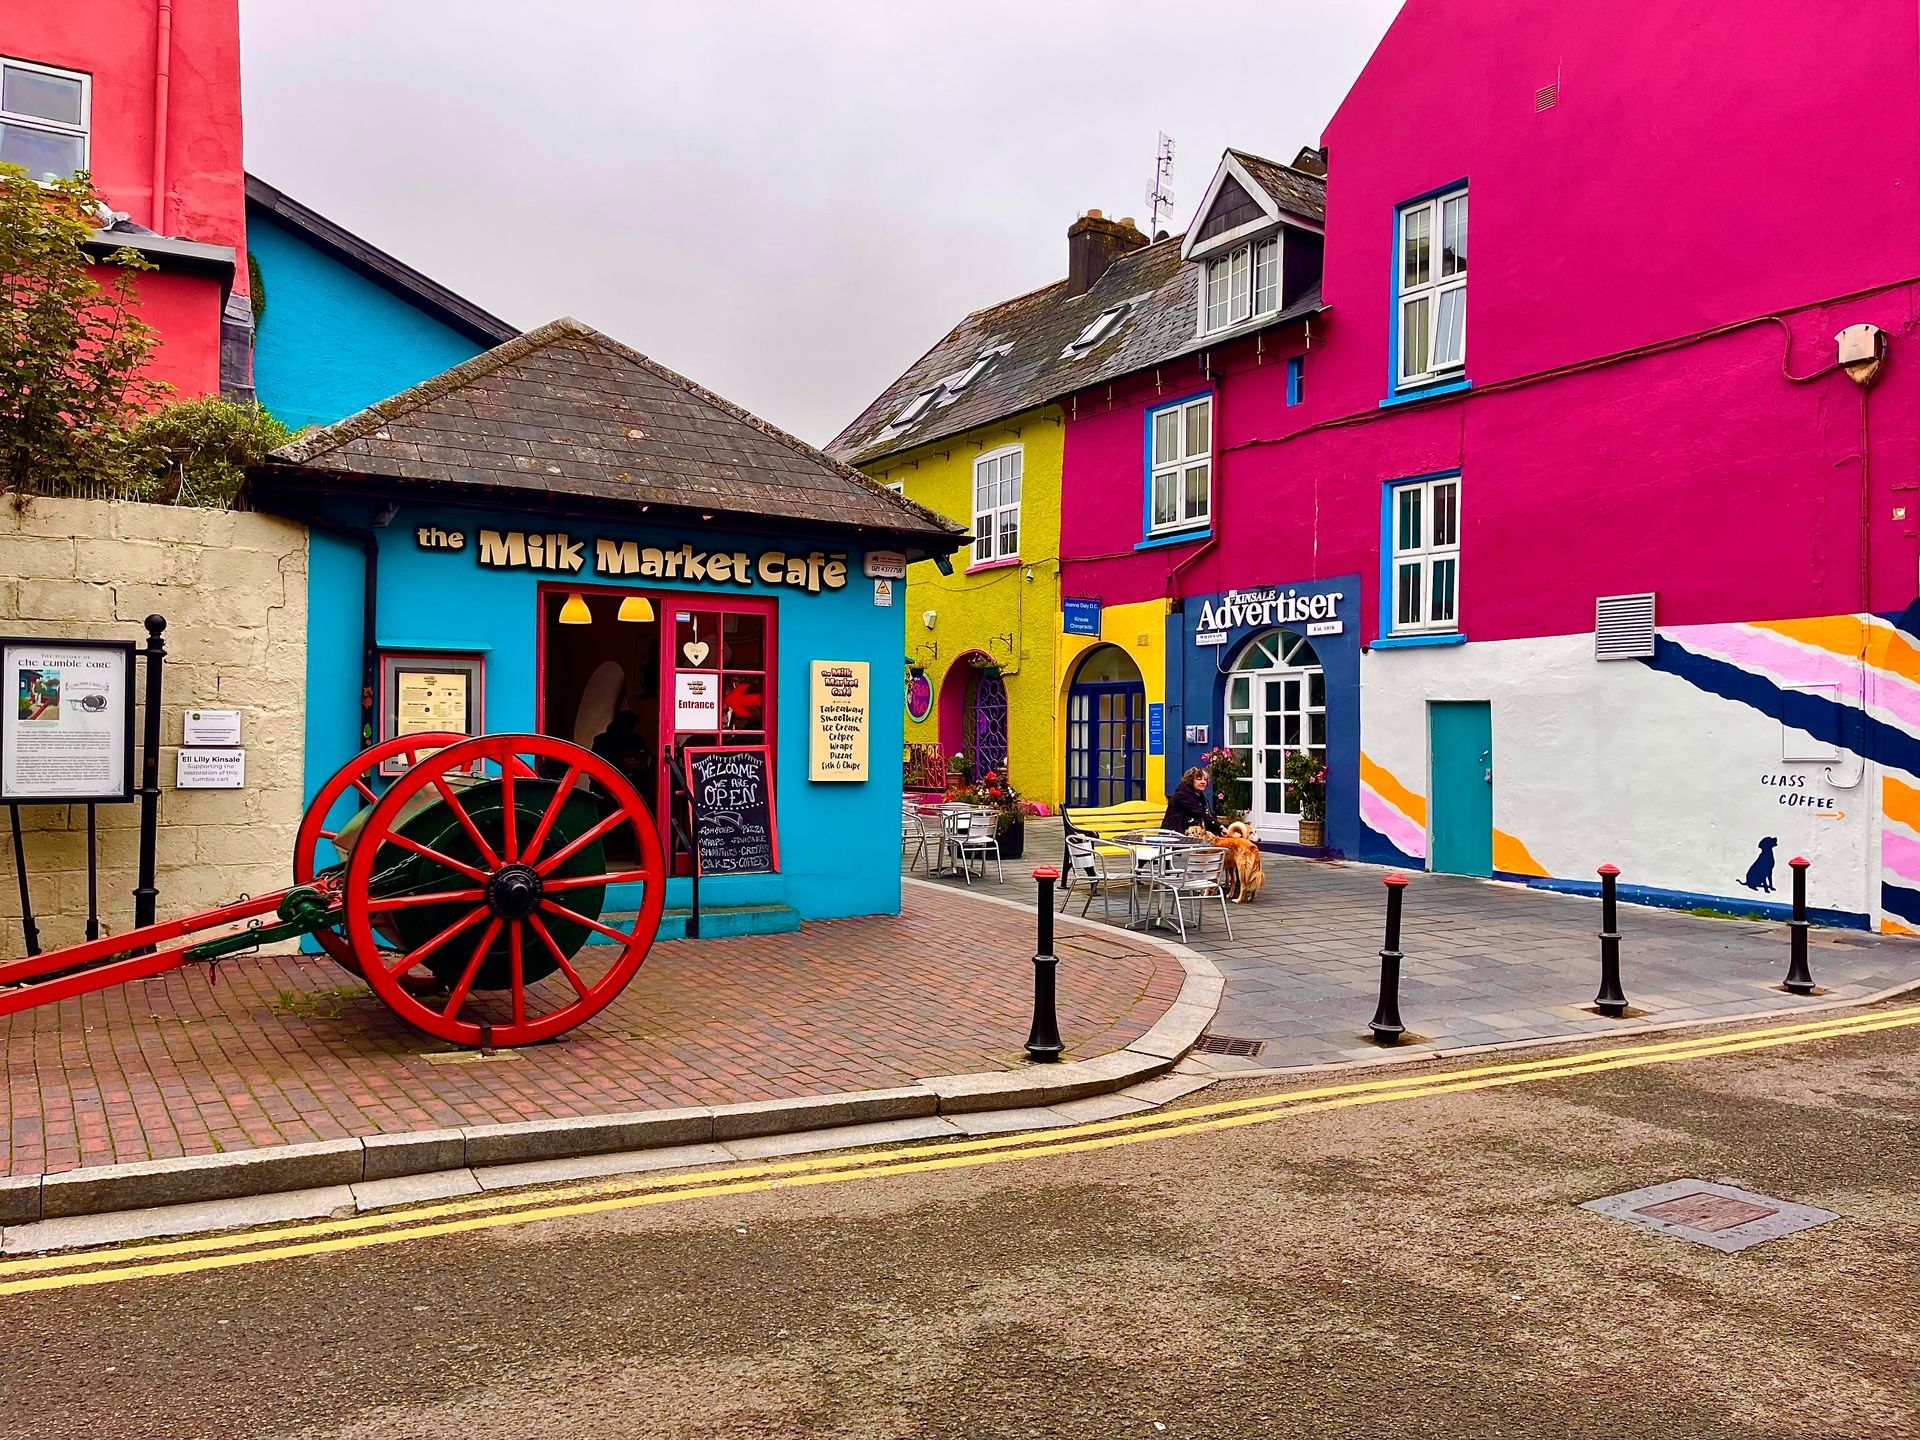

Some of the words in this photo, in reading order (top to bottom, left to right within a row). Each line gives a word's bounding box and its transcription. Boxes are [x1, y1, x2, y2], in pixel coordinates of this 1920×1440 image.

[417, 527, 465, 549] the
[479, 529, 585, 572] Milk
[596, 538, 752, 584] Market
[758, 551, 847, 592] Café
[1234, 589, 1276, 605] KINSALE
[1195, 588, 1344, 632] Advertiser
[42, 659, 82, 668] tumble
[831, 667, 853, 678] Milk
[824, 678, 859, 688] Market
[678, 699, 715, 710] Entrance
[820, 705, 864, 716] Takeaway
[820, 714, 863, 724] Smoothies
[835, 723, 860, 732] Cream
[830, 743, 854, 751] Wraps
[194, 756, 210, 764] Lilly
[830, 752, 853, 760] Pizzas
[842, 761, 861, 771] Chips
[698, 761, 760, 783] WELCOME
[713, 778, 728, 788] WE
[731, 778, 749, 788] ARE
[1761, 774, 1806, 788] CLASS
[704, 783, 758, 807] OPEN
[1779, 793, 1834, 809] COFFEE
[701, 858, 737, 871] CAKES
